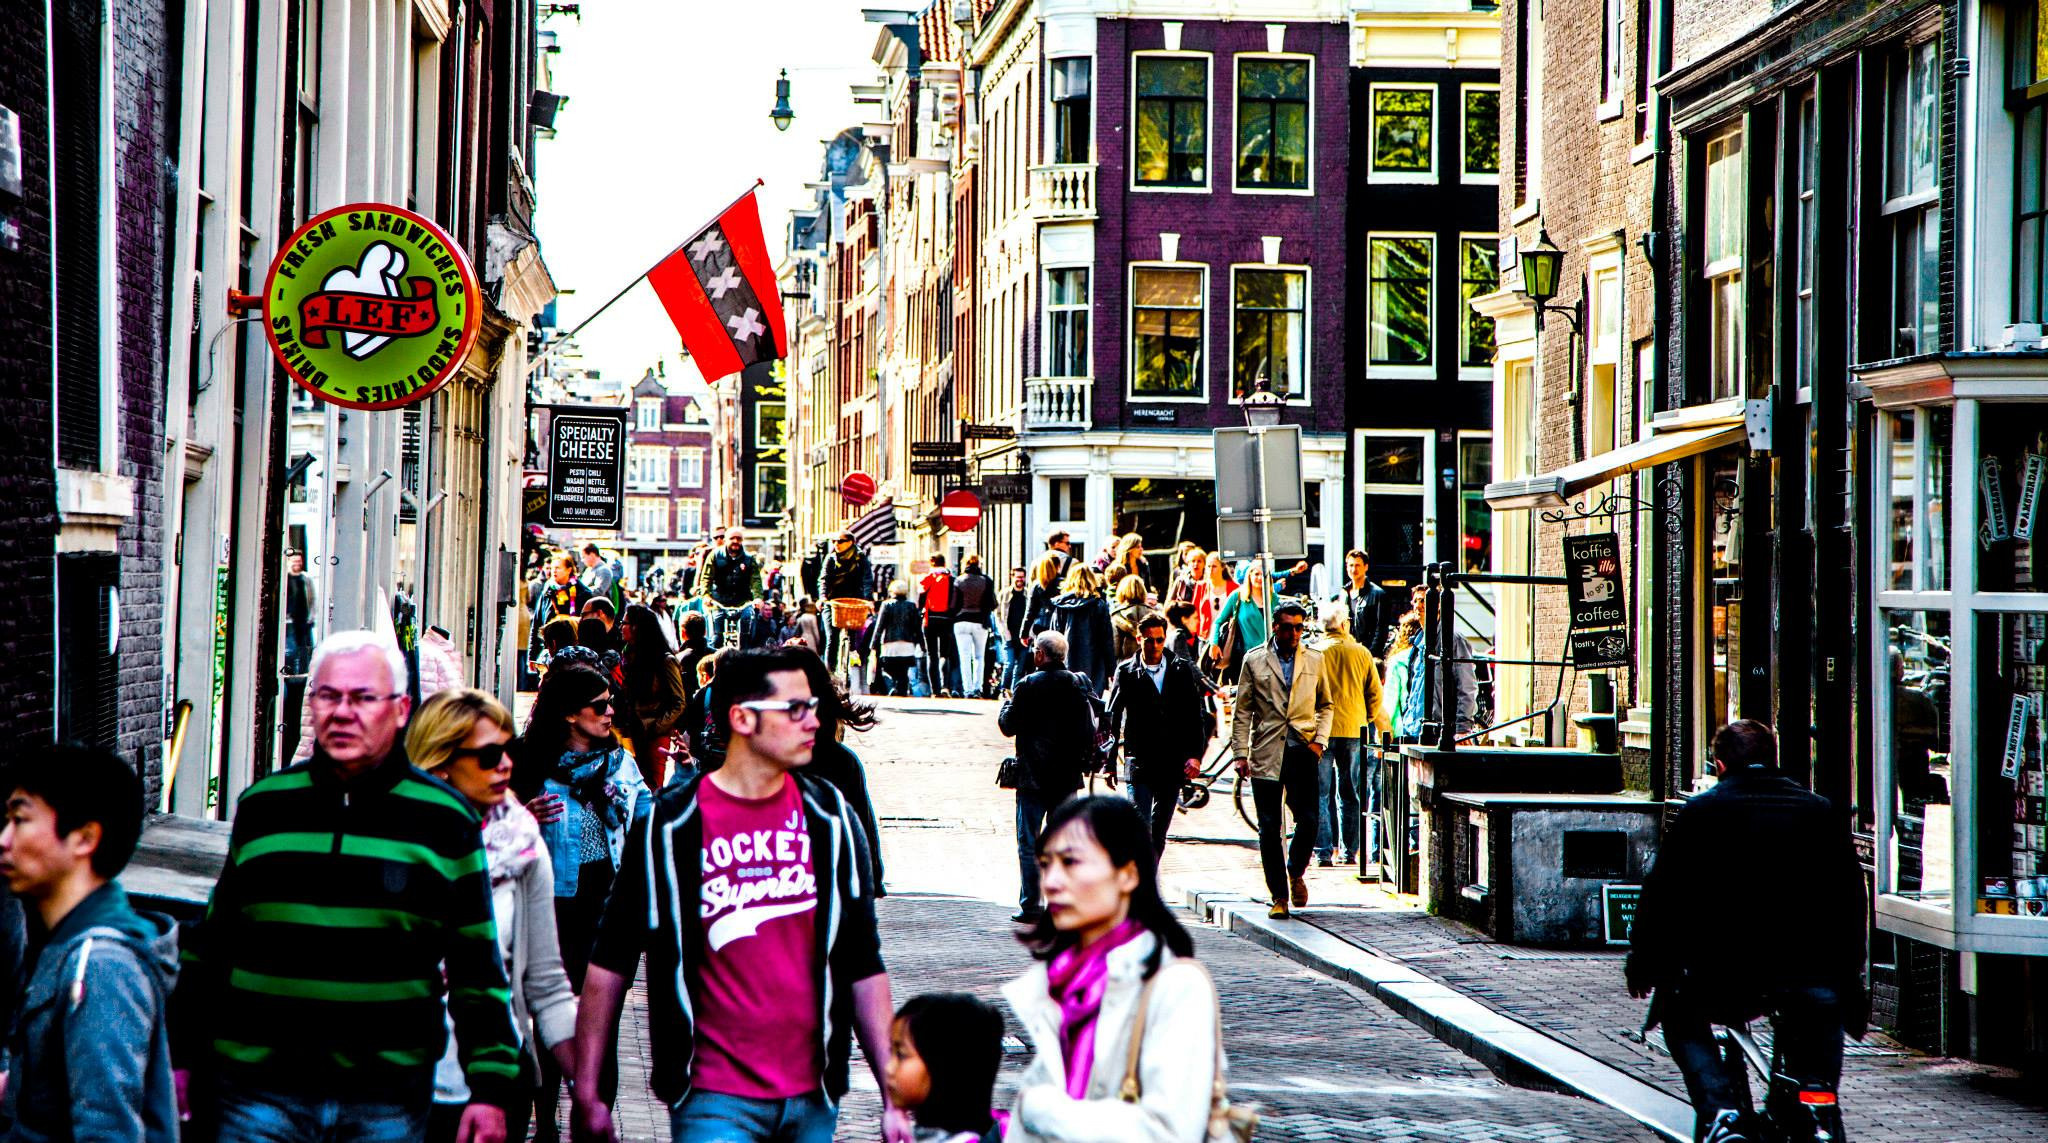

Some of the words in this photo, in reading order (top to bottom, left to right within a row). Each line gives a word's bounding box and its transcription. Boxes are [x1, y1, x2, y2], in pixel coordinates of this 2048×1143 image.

[278, 220, 337, 280] FRESH
[347, 212, 464, 297] SANDWICHES
[324, 296, 417, 331] LEF
[272, 315, 329, 389] DRINKS
[356, 326, 463, 404] SMOOTHIES
[560, 426, 615, 441] SPECIALTY
[559, 440, 614, 460] CHEESE
[569, 468, 585, 476] PESTO
[588, 469, 602, 477] CHILI
[565, 477, 585, 485] WASABI
[588, 478, 606, 486] NETTLE
[563, 485, 584, 493] SMOKED
[554, 493, 584, 502] FENUGREEK
[587, 495, 615, 503] CONTADINO
[563, 507, 573, 515] AND
[1572, 543, 1612, 560] koffie
[1599, 560, 1615, 574] illy
[1586, 590, 1595, 598] to
[1594, 583, 1605, 594] go
[1576, 606, 1620, 622] coffee
[1574, 640, 1595, 649] tosti's
[1576, 661, 1597, 669] toasted
[1752, 666, 1765, 676] 6A
[2008, 700, 2024, 760] AMSTERDAM
[785, 809, 807, 831] J
